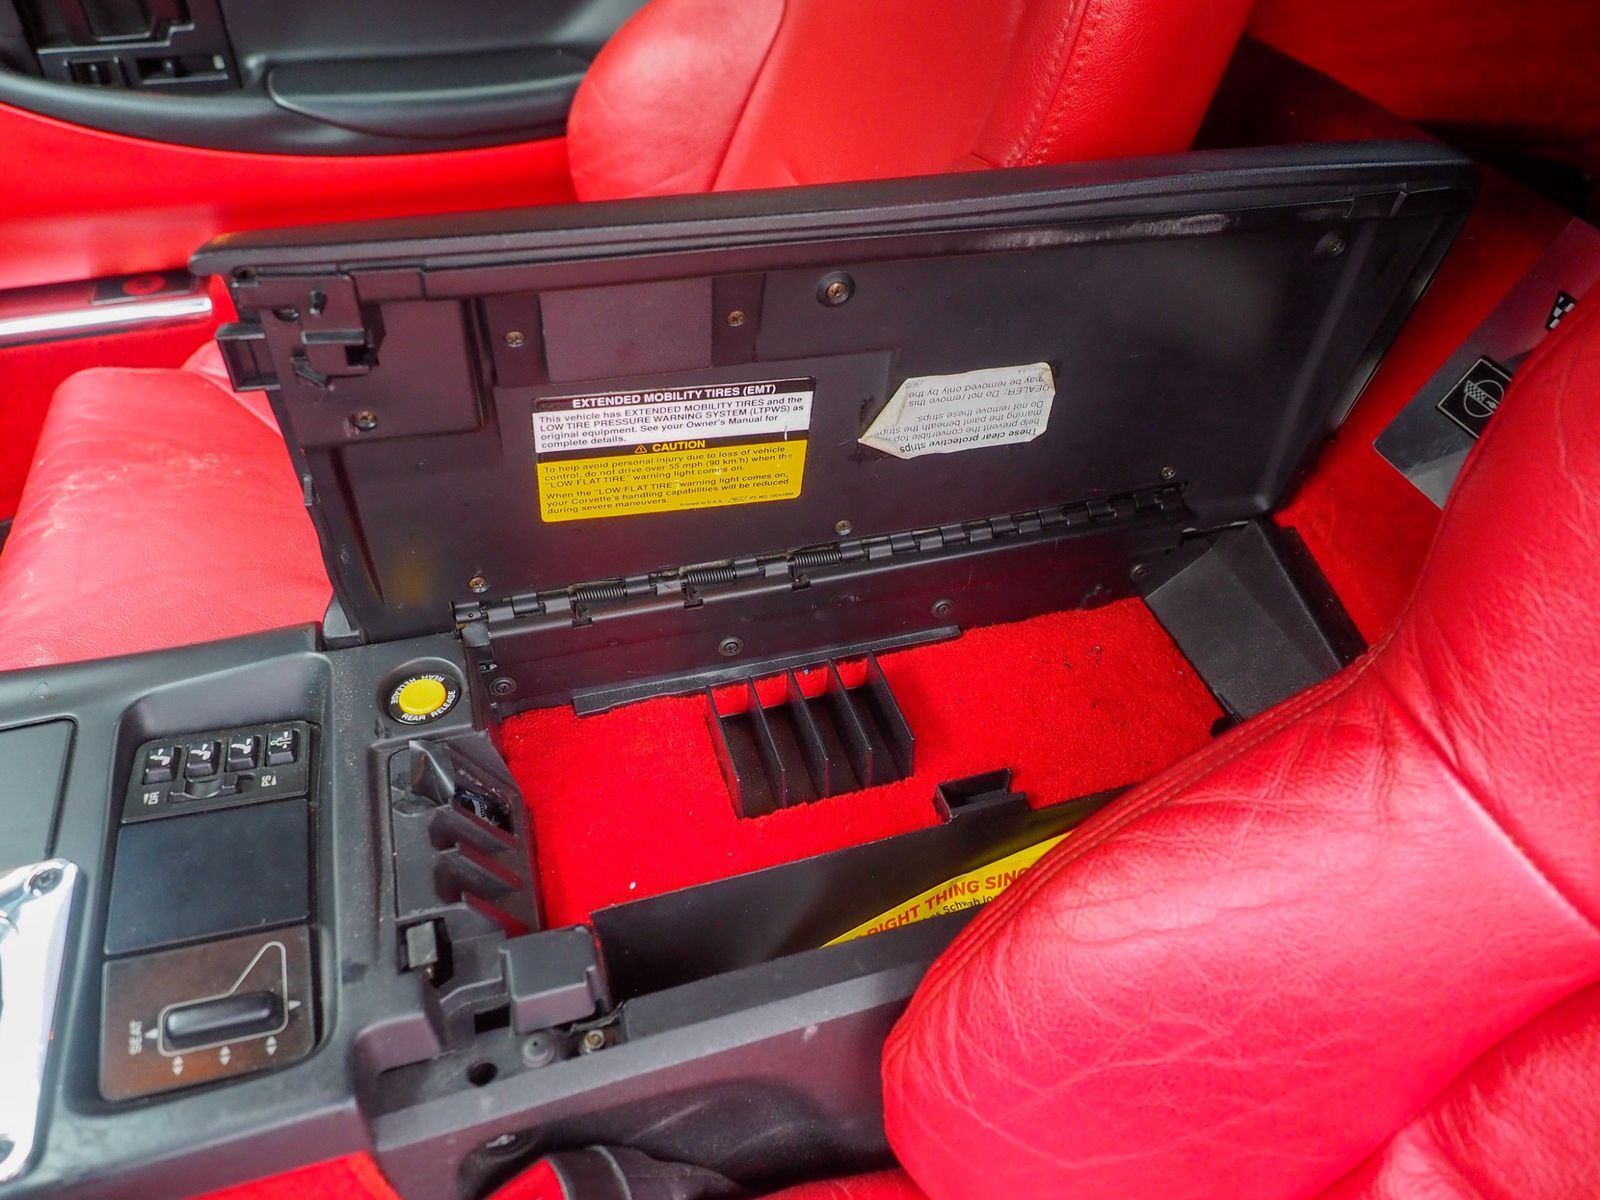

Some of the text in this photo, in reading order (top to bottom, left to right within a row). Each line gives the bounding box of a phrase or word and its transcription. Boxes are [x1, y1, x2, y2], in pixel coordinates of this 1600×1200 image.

[965, 382, 1006, 392] removed
[572, 384, 776, 408] EXTENDED MOBILITY TIRES (EMT)
[929, 395, 966, 404] remove
[564, 412, 600, 422] vehicle
[624, 406, 680, 416] EXTENDED
[684, 402, 731, 412] MOBILITY
[735, 399, 763, 407] TIRES
[767, 397, 784, 405] and
[976, 405, 1010, 414] remove
[1007, 410, 1041, 419] marring
[540, 423, 564, 432] LOW
[567, 421, 590, 430] TIRE
[594, 416, 650, 427] PRESSURE
[653, 412, 702, 422] WARNING
[705, 408, 746, 418] SYSTEM
[750, 405, 790, 416] (LTPWS)
[963, 417, 986, 426] paint
[1020, 418, 1039, 426] help
[541, 430, 578, 440] original
[582, 426, 637, 437] equipment.
[661, 423, 682, 432] your
[686, 419, 725, 428] Owner's
[728, 416, 762, 424] Manual
[922, 420, 961, 430] beneath
[983, 420, 1018, 431] prevent
[912, 429, 963, 440] convertible
[982, 432, 1005, 440] clear
[541, 436, 626, 448] complete details.
[929, 434, 979, 447] protective
[652, 440, 706, 453] CAUTION
[900, 443, 926, 453] strips
[582, 462, 608, 470] avoid
[612, 458, 653, 468] personal
[753, 446, 785, 454] vehicle
[669, 462, 679, 470] 55
[683, 461, 702, 469] mph
[706, 459, 719, 468] (90
[633, 472, 670, 480] warning
[674, 469, 694, 478] light
[679, 479, 716, 487] warning
[719, 476, 738, 485] light
[546, 499, 567, 508] your
[571, 494, 619, 505] Corvette's
[622, 491, 662, 500] handling
[666, 486, 717, 496] capabilities
[752, 478, 788, 487] reduced
[547, 506, 578, 515] during
[615, 498, 668, 508] maneuvers.
[401, 690, 456, 721] REAR RELEASE
[924, 880, 980, 910] THING
[128, 1020, 143, 1055] SEAT
